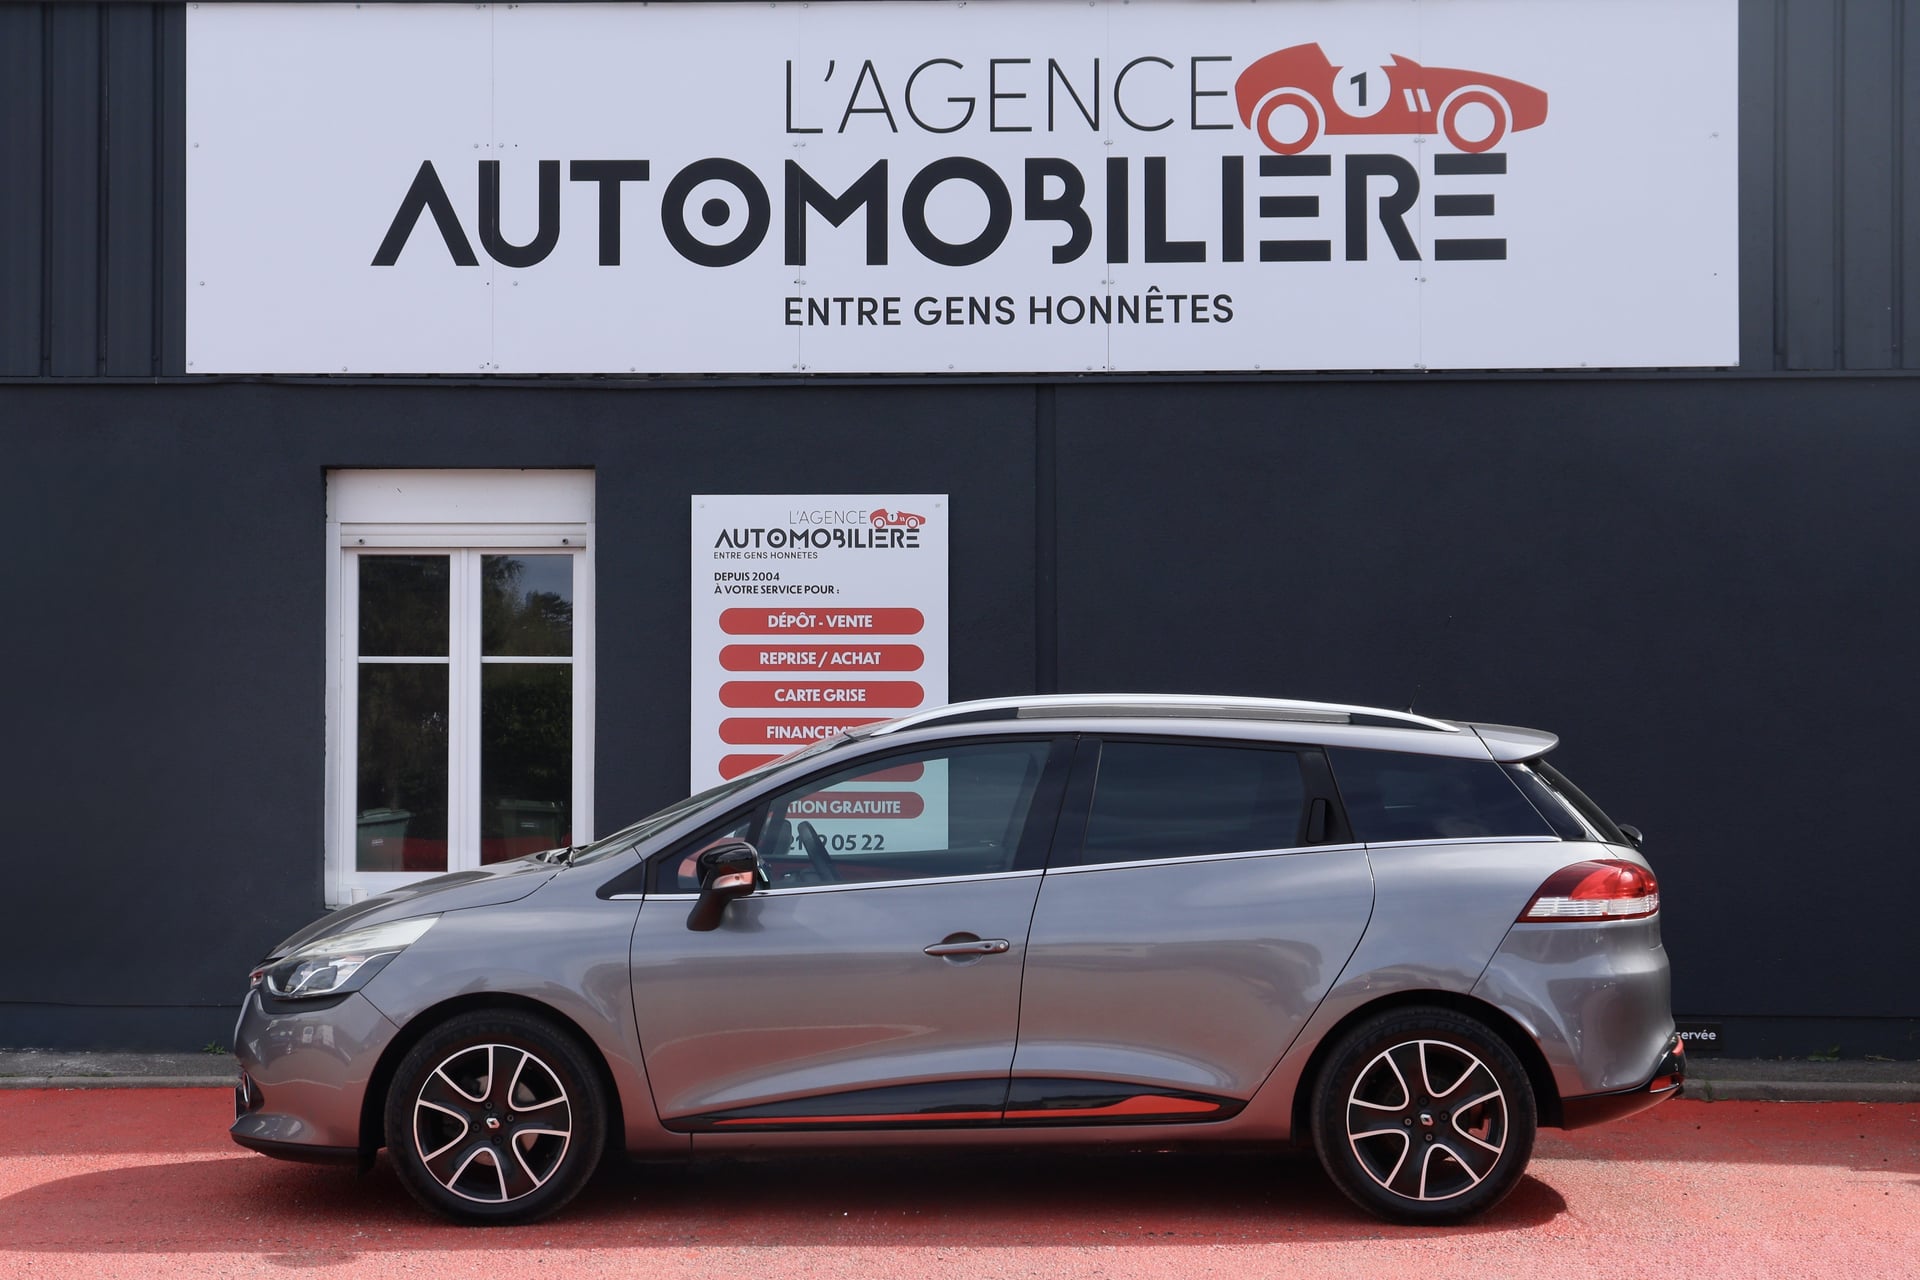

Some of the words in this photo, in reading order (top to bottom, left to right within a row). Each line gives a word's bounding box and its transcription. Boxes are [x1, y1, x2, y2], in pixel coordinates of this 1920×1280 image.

[786, 56, 1234, 133] L'AGENCE
[1350, 71, 1367, 107] 1
[785, 296, 901, 326] ENTRE
[914, 295, 1016, 326] GENS
[1029, 285, 1234, 326] HONNÊTES
[789, 510, 867, 524] L'AGENCE
[713, 551, 742, 560] ENTRE
[743, 551, 768, 560] GENS
[714, 572, 750, 581] DEPUIS
[752, 572, 780, 581] 2004
[714, 583, 722, 594] À
[724, 585, 759, 594] VOTRE
[760, 585, 802, 594] SERVICE
[804, 585, 834, 594] POUR
[767, 612, 816, 628] DÉPÔT
[826, 615, 873, 628] VENTE
[760, 652, 816, 665] REPRISE
[830, 652, 881, 665] ACHAT
[774, 689, 820, 702] CARTE
[823, 689, 866, 702] GRISE
[766, 726, 856, 739] FINANCEM
[829, 800, 901, 813] GRATUITE
[831, 834, 857, 850] 05
[861, 834, 885, 850] 22
[1676, 1030, 1716, 1040] ervée
